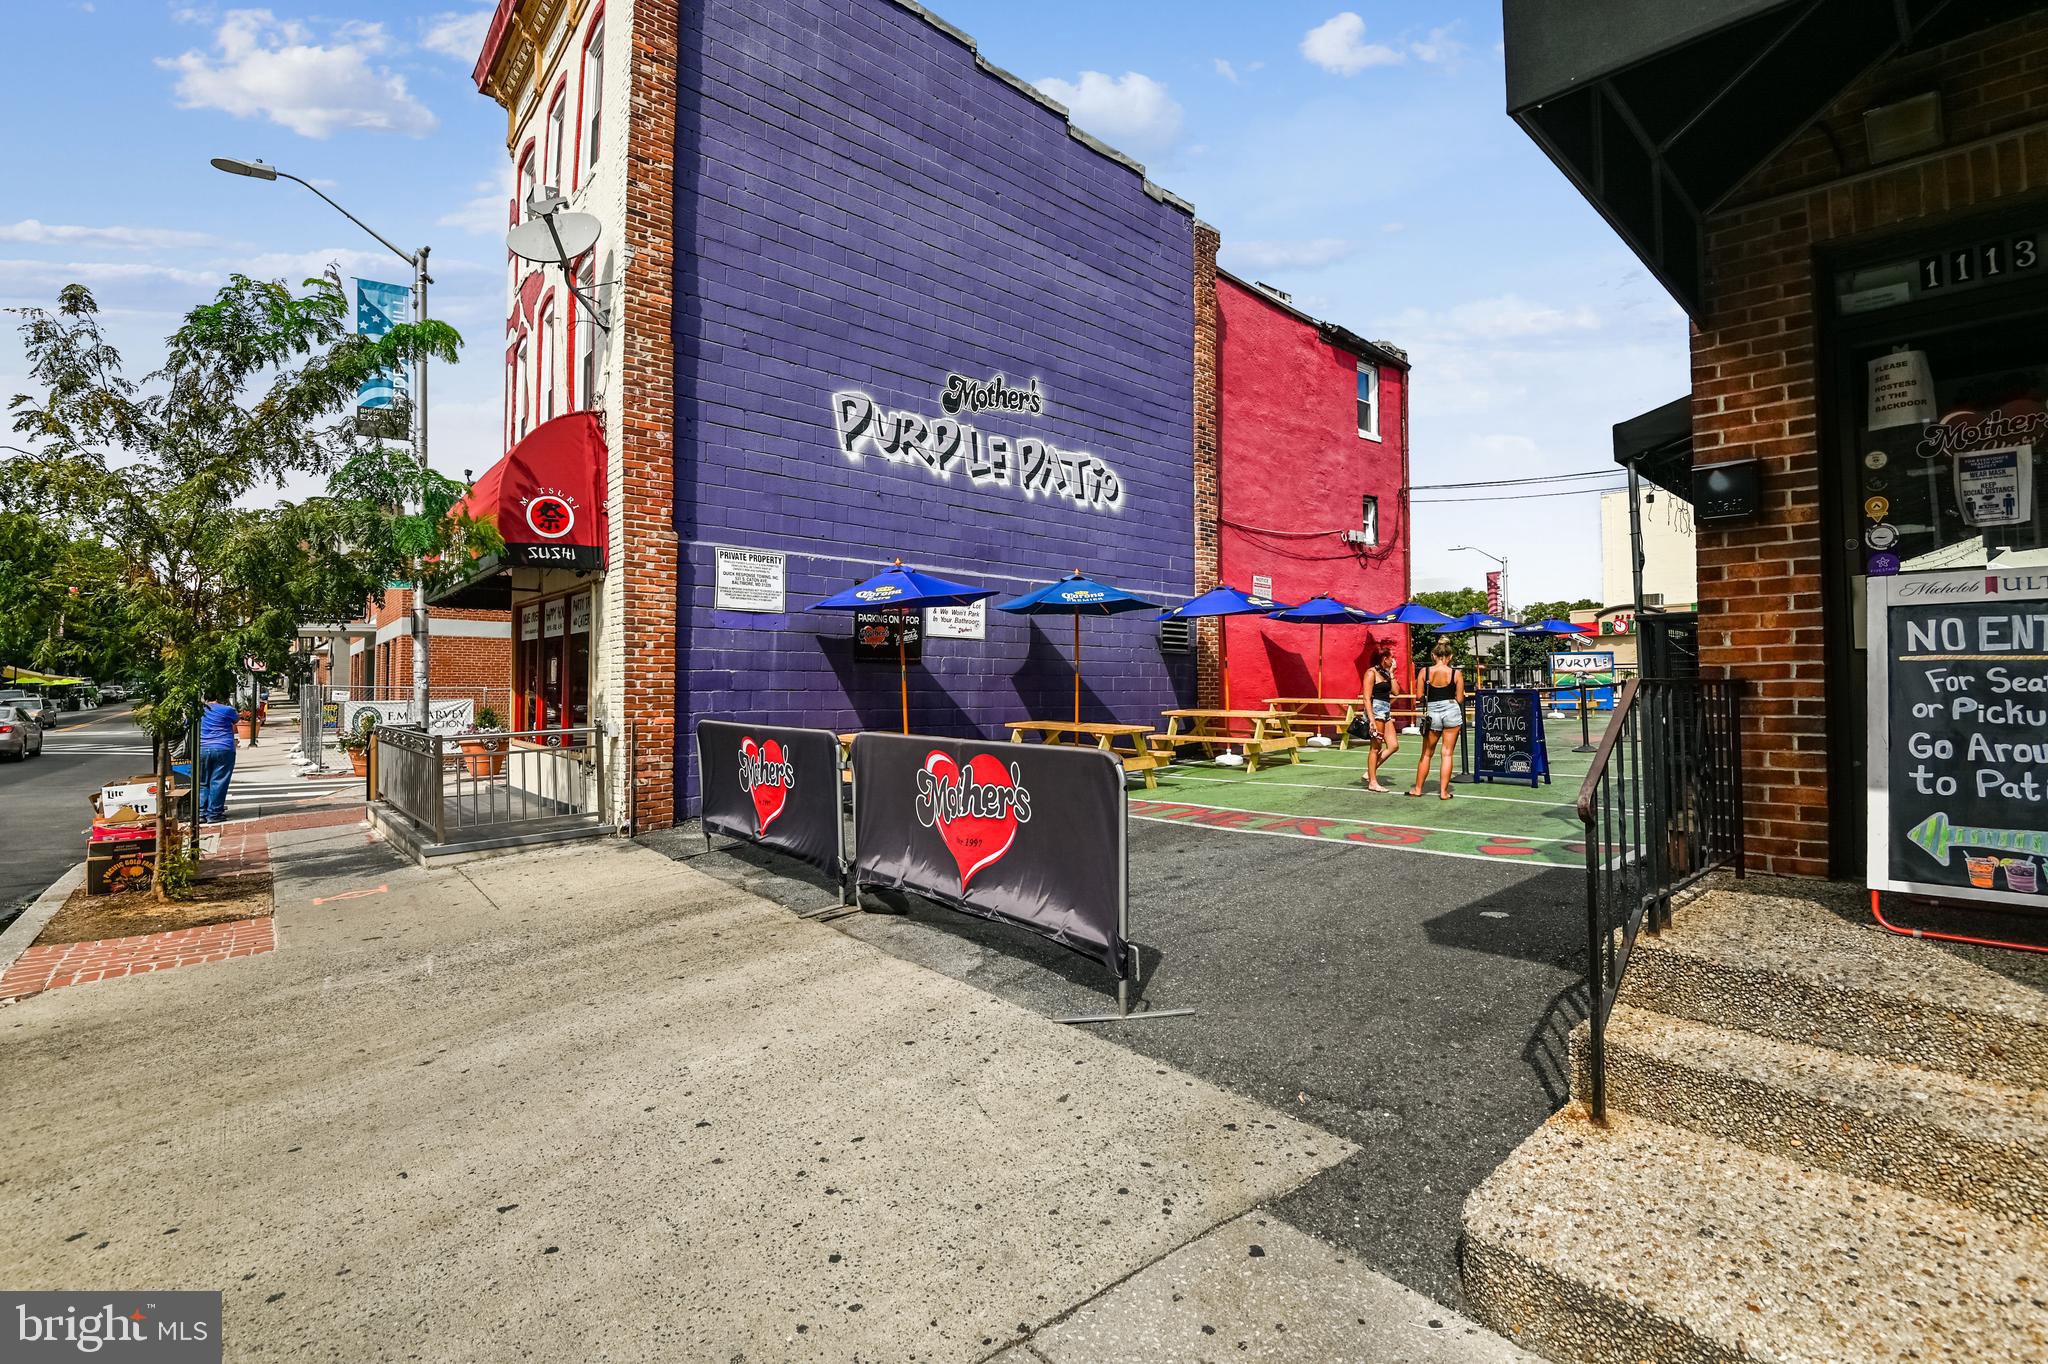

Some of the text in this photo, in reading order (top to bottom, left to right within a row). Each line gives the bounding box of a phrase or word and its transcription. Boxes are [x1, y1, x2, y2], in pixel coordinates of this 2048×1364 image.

[1926, 240, 2036, 288] 1113
[1874, 360, 1908, 373] PLEASE
[942, 374, 1042, 414] Mother's
[1874, 380, 1917, 393] HOSTESS
[1875, 391, 1908, 403] AT THE
[1875, 399, 1928, 413] BACKDOOR
[833, 392, 1010, 485] PURPLE
[1985, 485, 2015, 495] DISTANCE
[527, 546, 577, 561] SUSHI
[719, 550, 747, 562] PRIVATE
[748, 553, 783, 565] PROPERTY
[855, 588, 902, 599] Corona
[1061, 592, 1105, 600] Corona
[1899, 580, 1980, 597] Michelob
[857, 613, 888, 624] PARKING
[905, 616, 920, 625] FOR
[968, 610, 980, 618] Park
[1906, 617, 1967, 652] NO
[1556, 655, 1609, 668] PURPLE
[1924, 668, 1976, 693] For
[1482, 695, 1502, 714] FOR
[1912, 702, 1945, 719] or
[1908, 731, 1954, 760] Go
[1908, 764, 1957, 796] to
[107, 790, 124, 800] Lite
[916, 761, 1032, 828] Mother's
[965, 837, 983, 847] 1997
